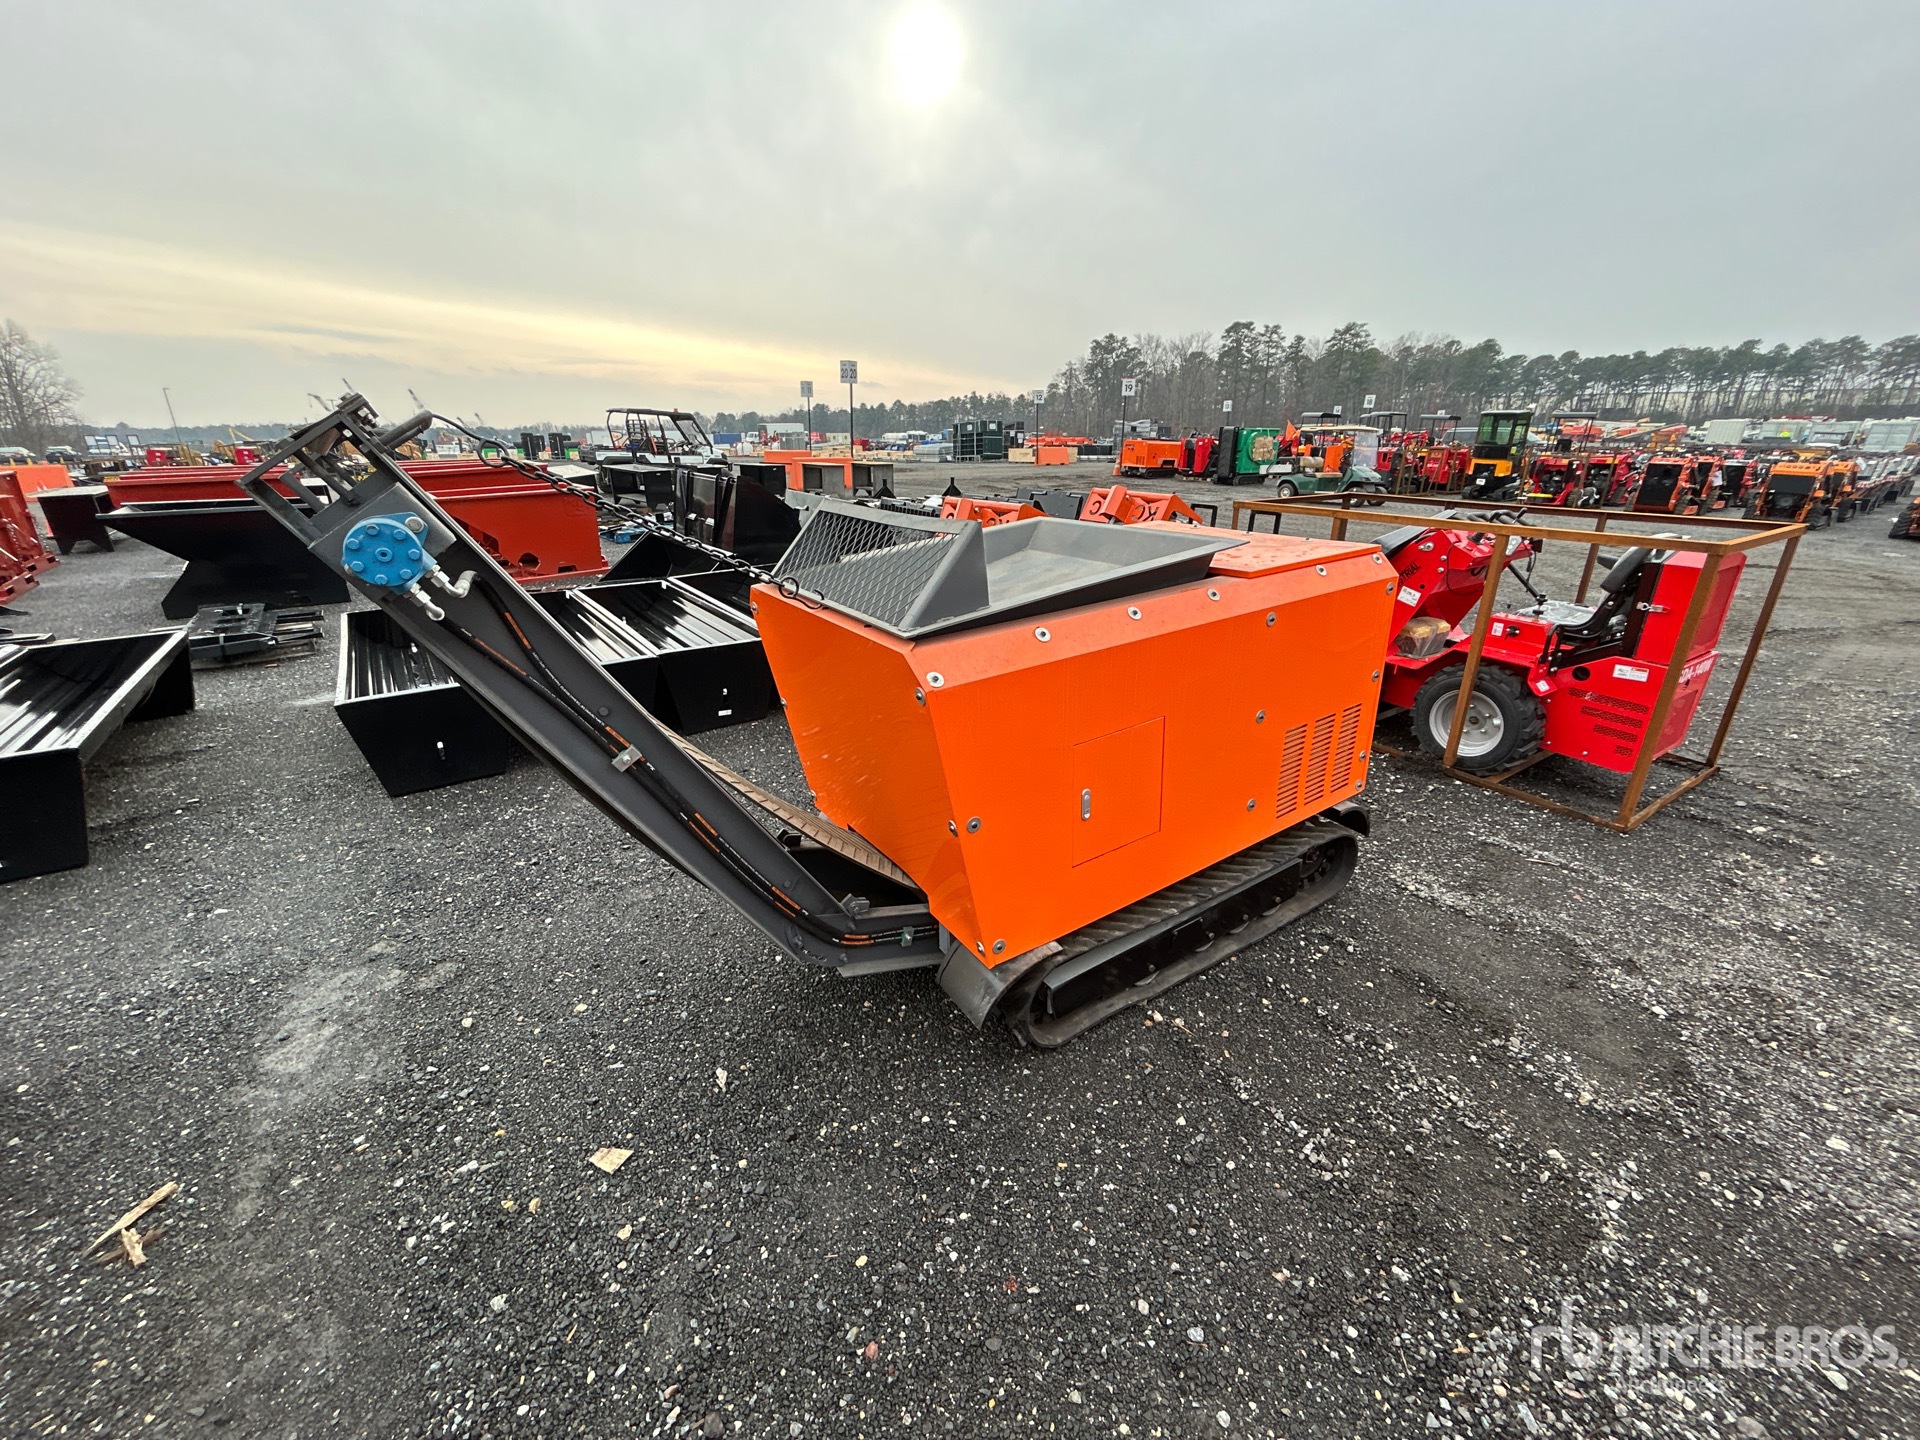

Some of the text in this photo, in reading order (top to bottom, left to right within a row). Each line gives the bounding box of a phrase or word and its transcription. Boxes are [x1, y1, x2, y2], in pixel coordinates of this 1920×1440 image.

[840, 367, 849, 379] 20
[850, 368, 857, 379] 20
[1125, 383, 1133, 392] 19
